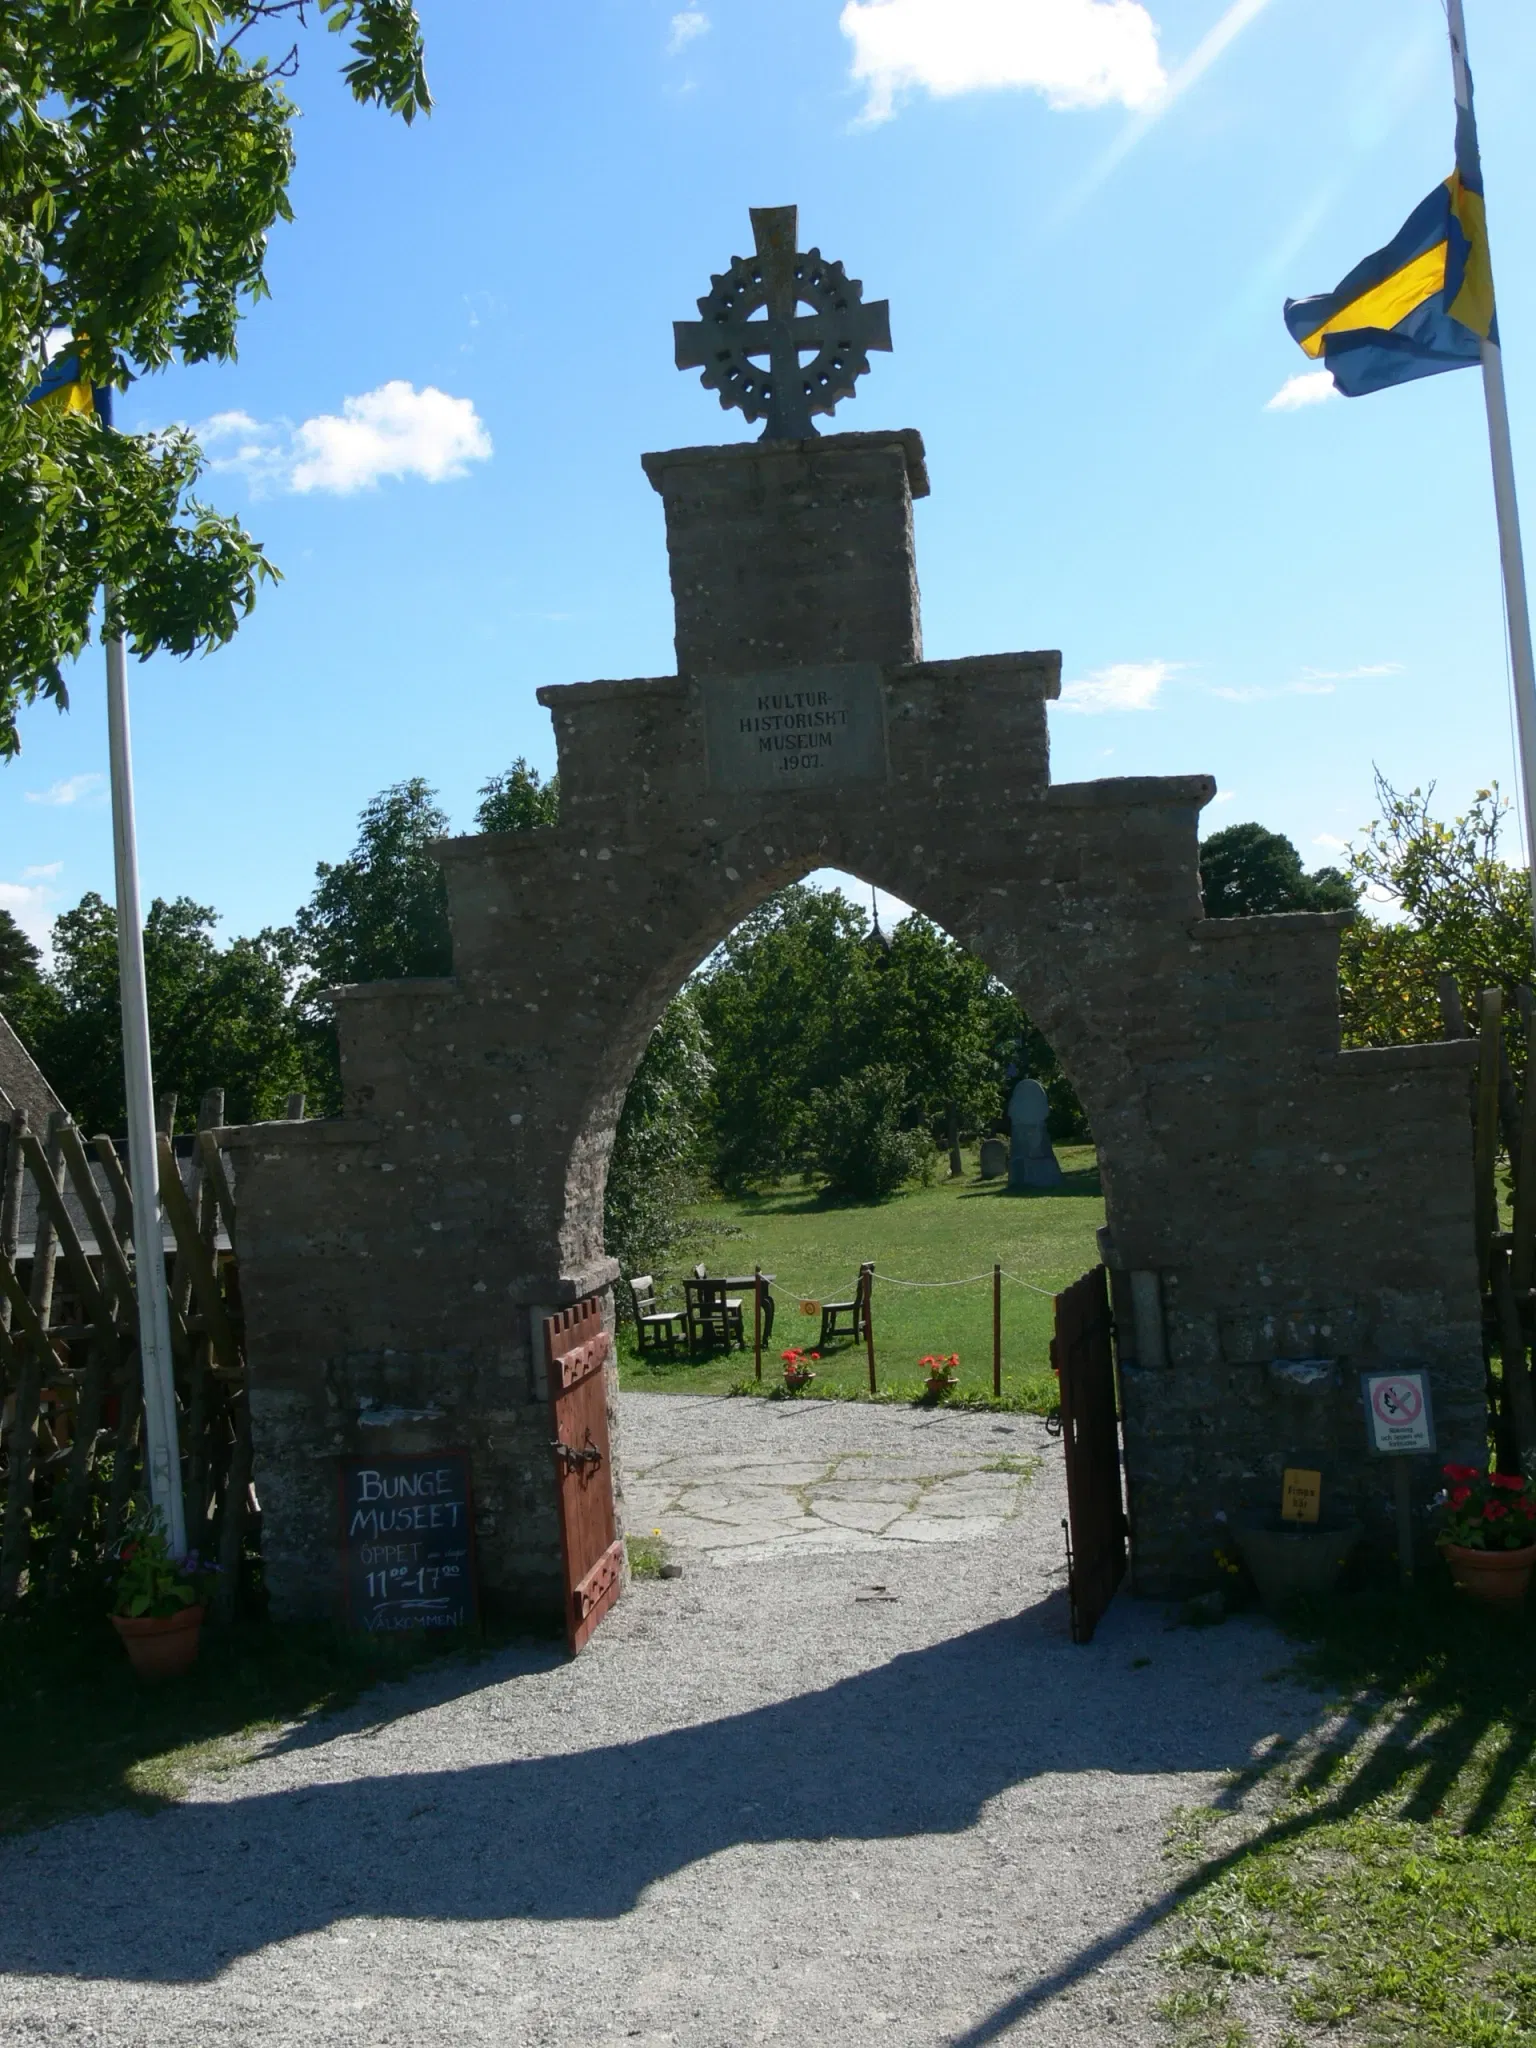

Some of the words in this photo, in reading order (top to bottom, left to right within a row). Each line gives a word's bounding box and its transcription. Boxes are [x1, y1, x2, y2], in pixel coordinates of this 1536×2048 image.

[739, 710, 849, 733] HISTORISKT
[759, 732, 832, 752] MUSEUM
[356, 1468, 453, 1503] BUNGE
[349, 1501, 465, 1540] MUSEET
[360, 1541, 424, 1565] ÖPPET
